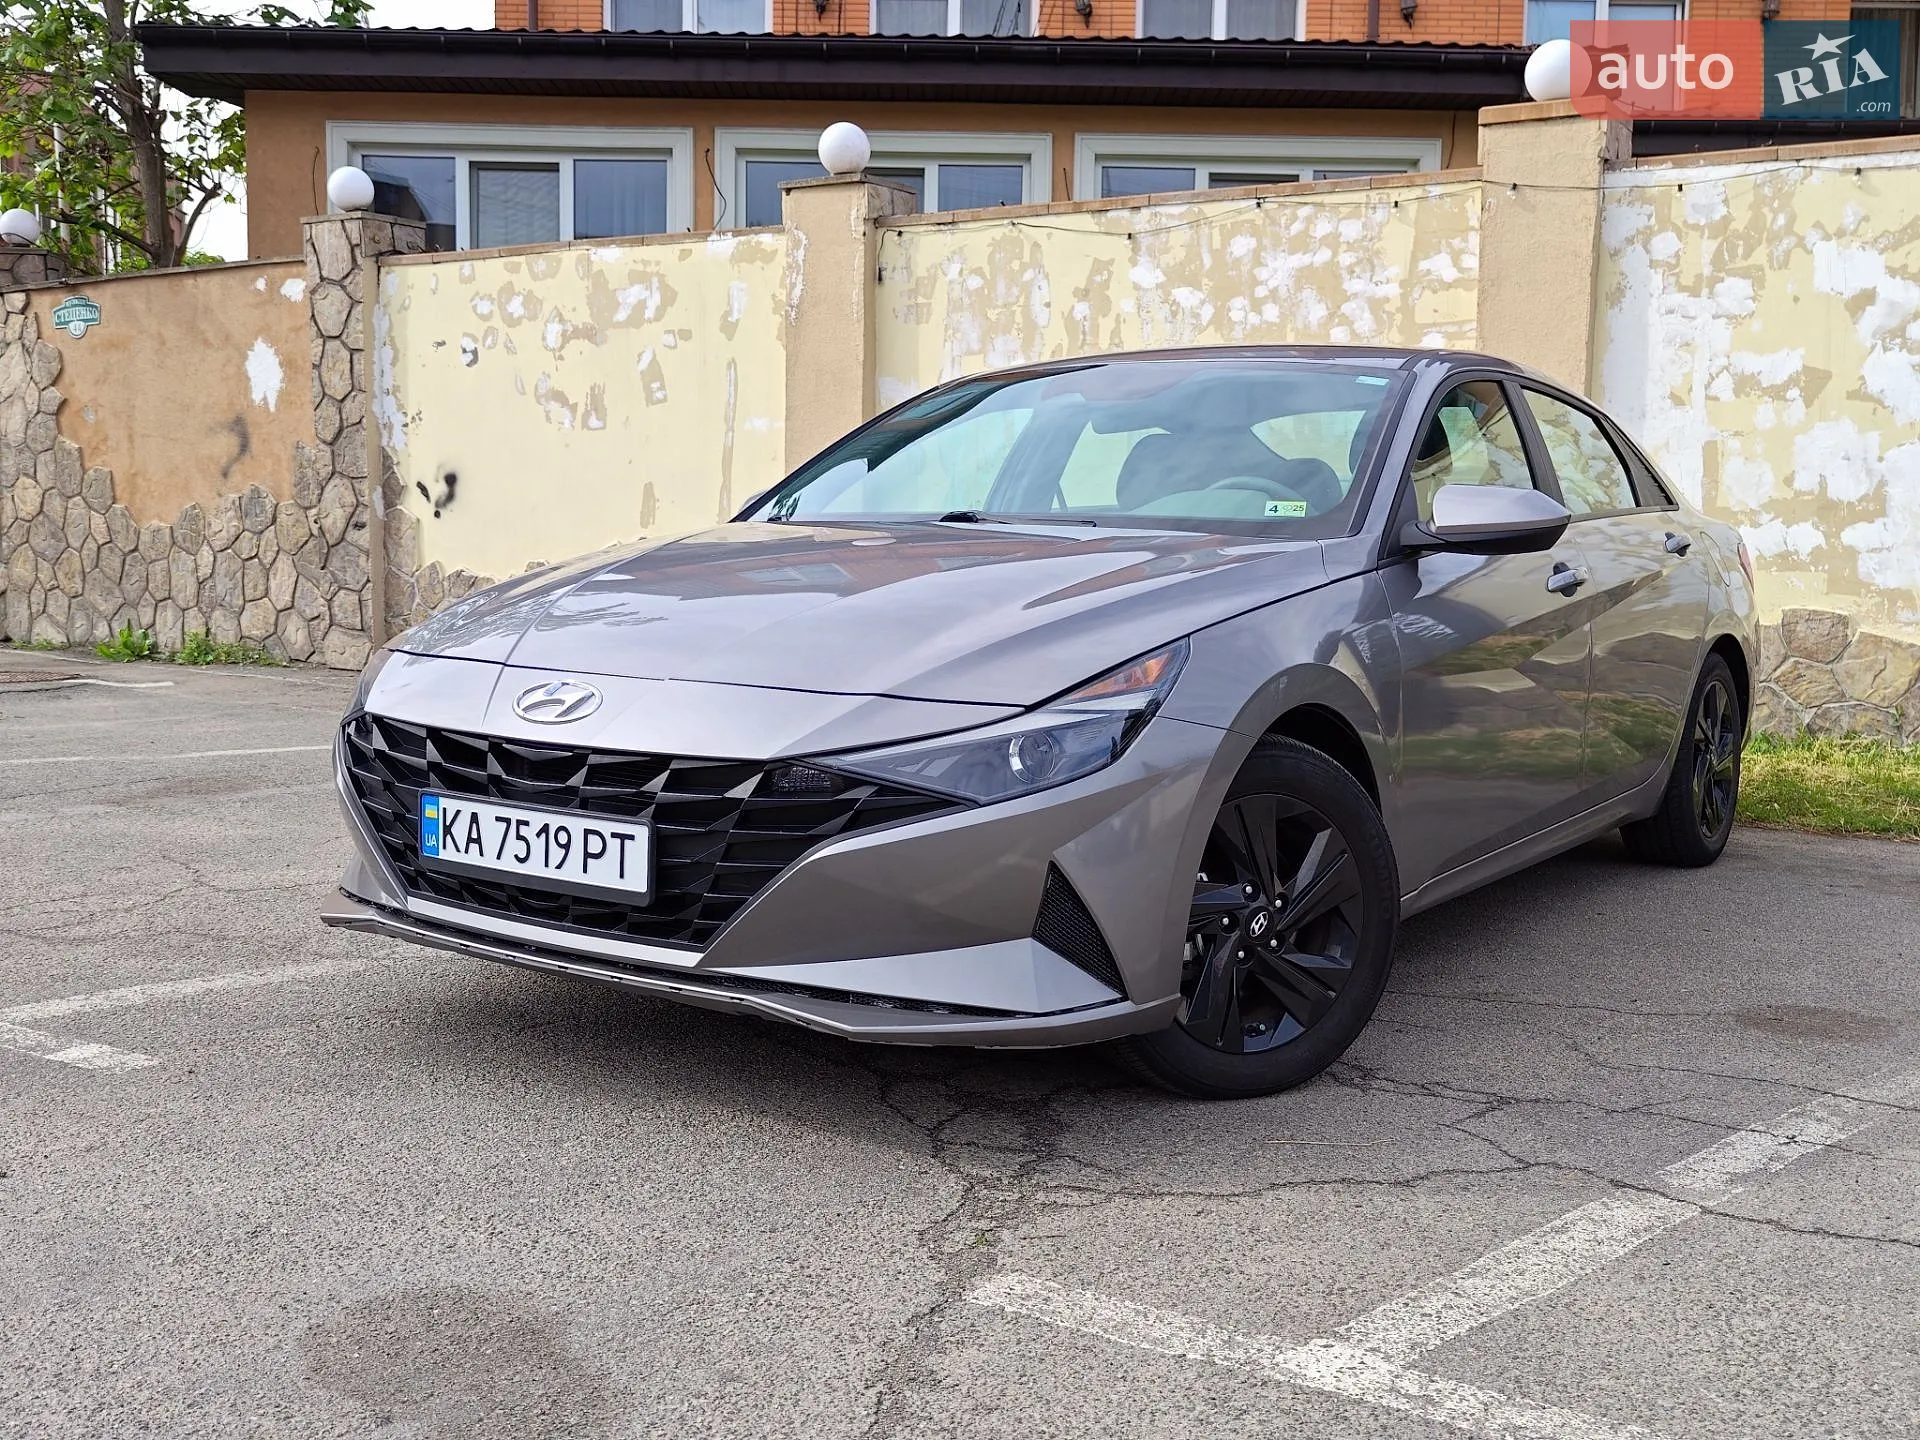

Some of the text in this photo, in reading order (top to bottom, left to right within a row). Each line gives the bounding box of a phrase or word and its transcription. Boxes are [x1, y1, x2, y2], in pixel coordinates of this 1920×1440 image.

[55, 306, 98, 322] СТЕЦЕНКО
[1268, 504, 1305, 514] 4 25
[425, 833, 438, 848] UA
[442, 806, 636, 880] KA 7519 PT
